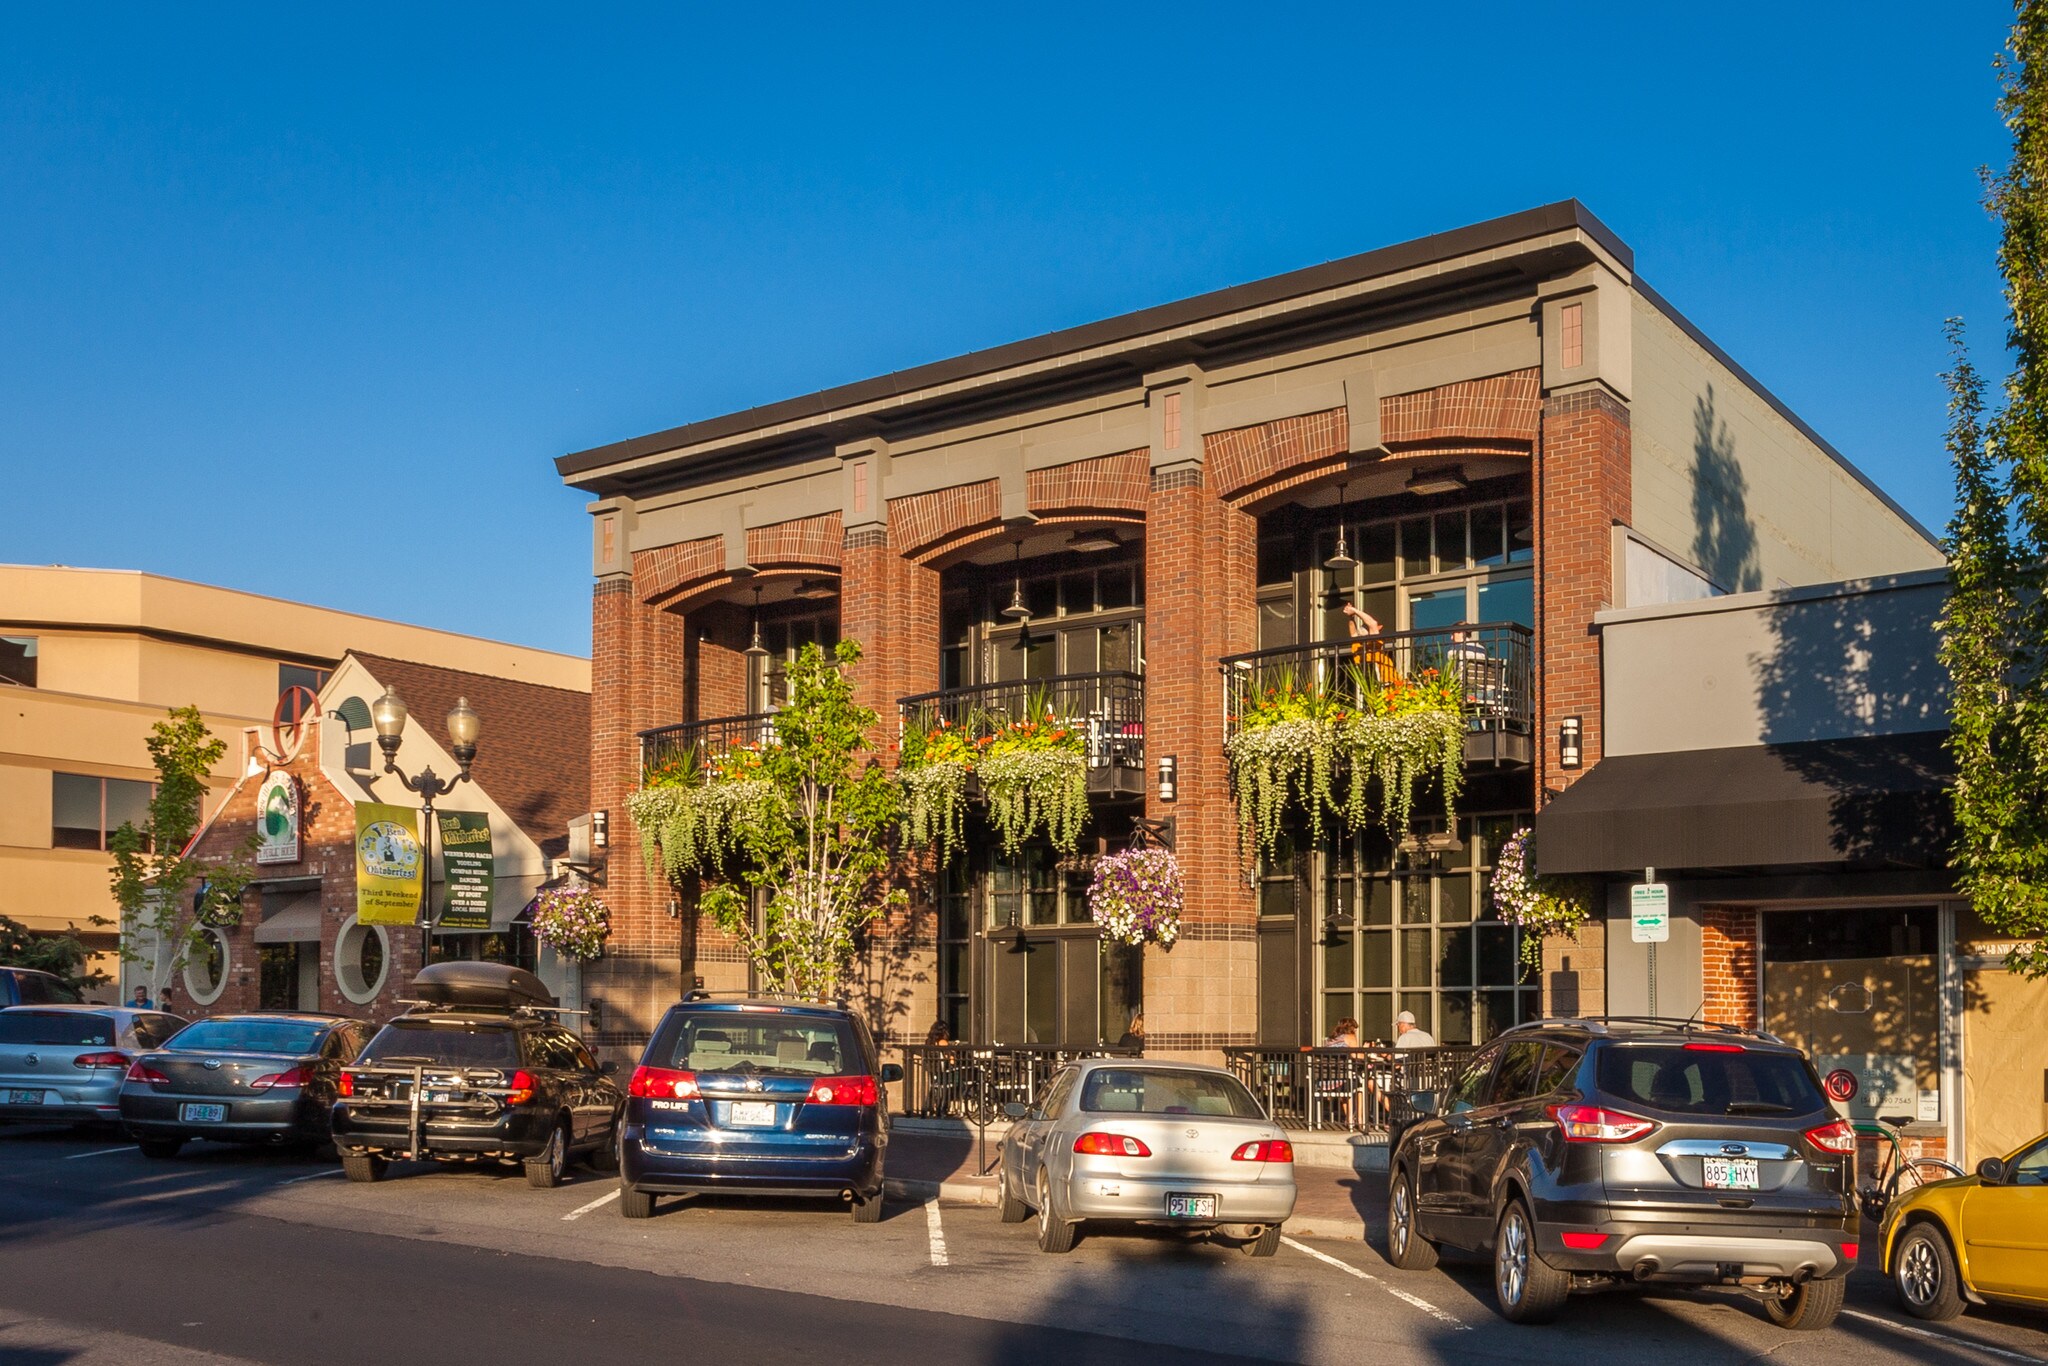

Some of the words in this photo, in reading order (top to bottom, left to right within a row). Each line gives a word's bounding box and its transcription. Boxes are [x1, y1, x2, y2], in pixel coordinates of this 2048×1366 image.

[361, 888, 383, 897] Third
[385, 889, 418, 898] Weekend
[375, 899, 414, 908] September
[1997, 944, 2009, 955] NW
[1863, 1069, 1893, 1078] BEND
[652, 1101, 670, 1109] PRO
[670, 1102, 689, 1111] LIFE
[1894, 1097, 1912, 1105] 7545
[1706, 1166, 1728, 1181] 885
[1735, 1167, 1756, 1182] HXY
[1171, 1199, 1188, 1212] 951
[1195, 1199, 1214, 1213] FSH
